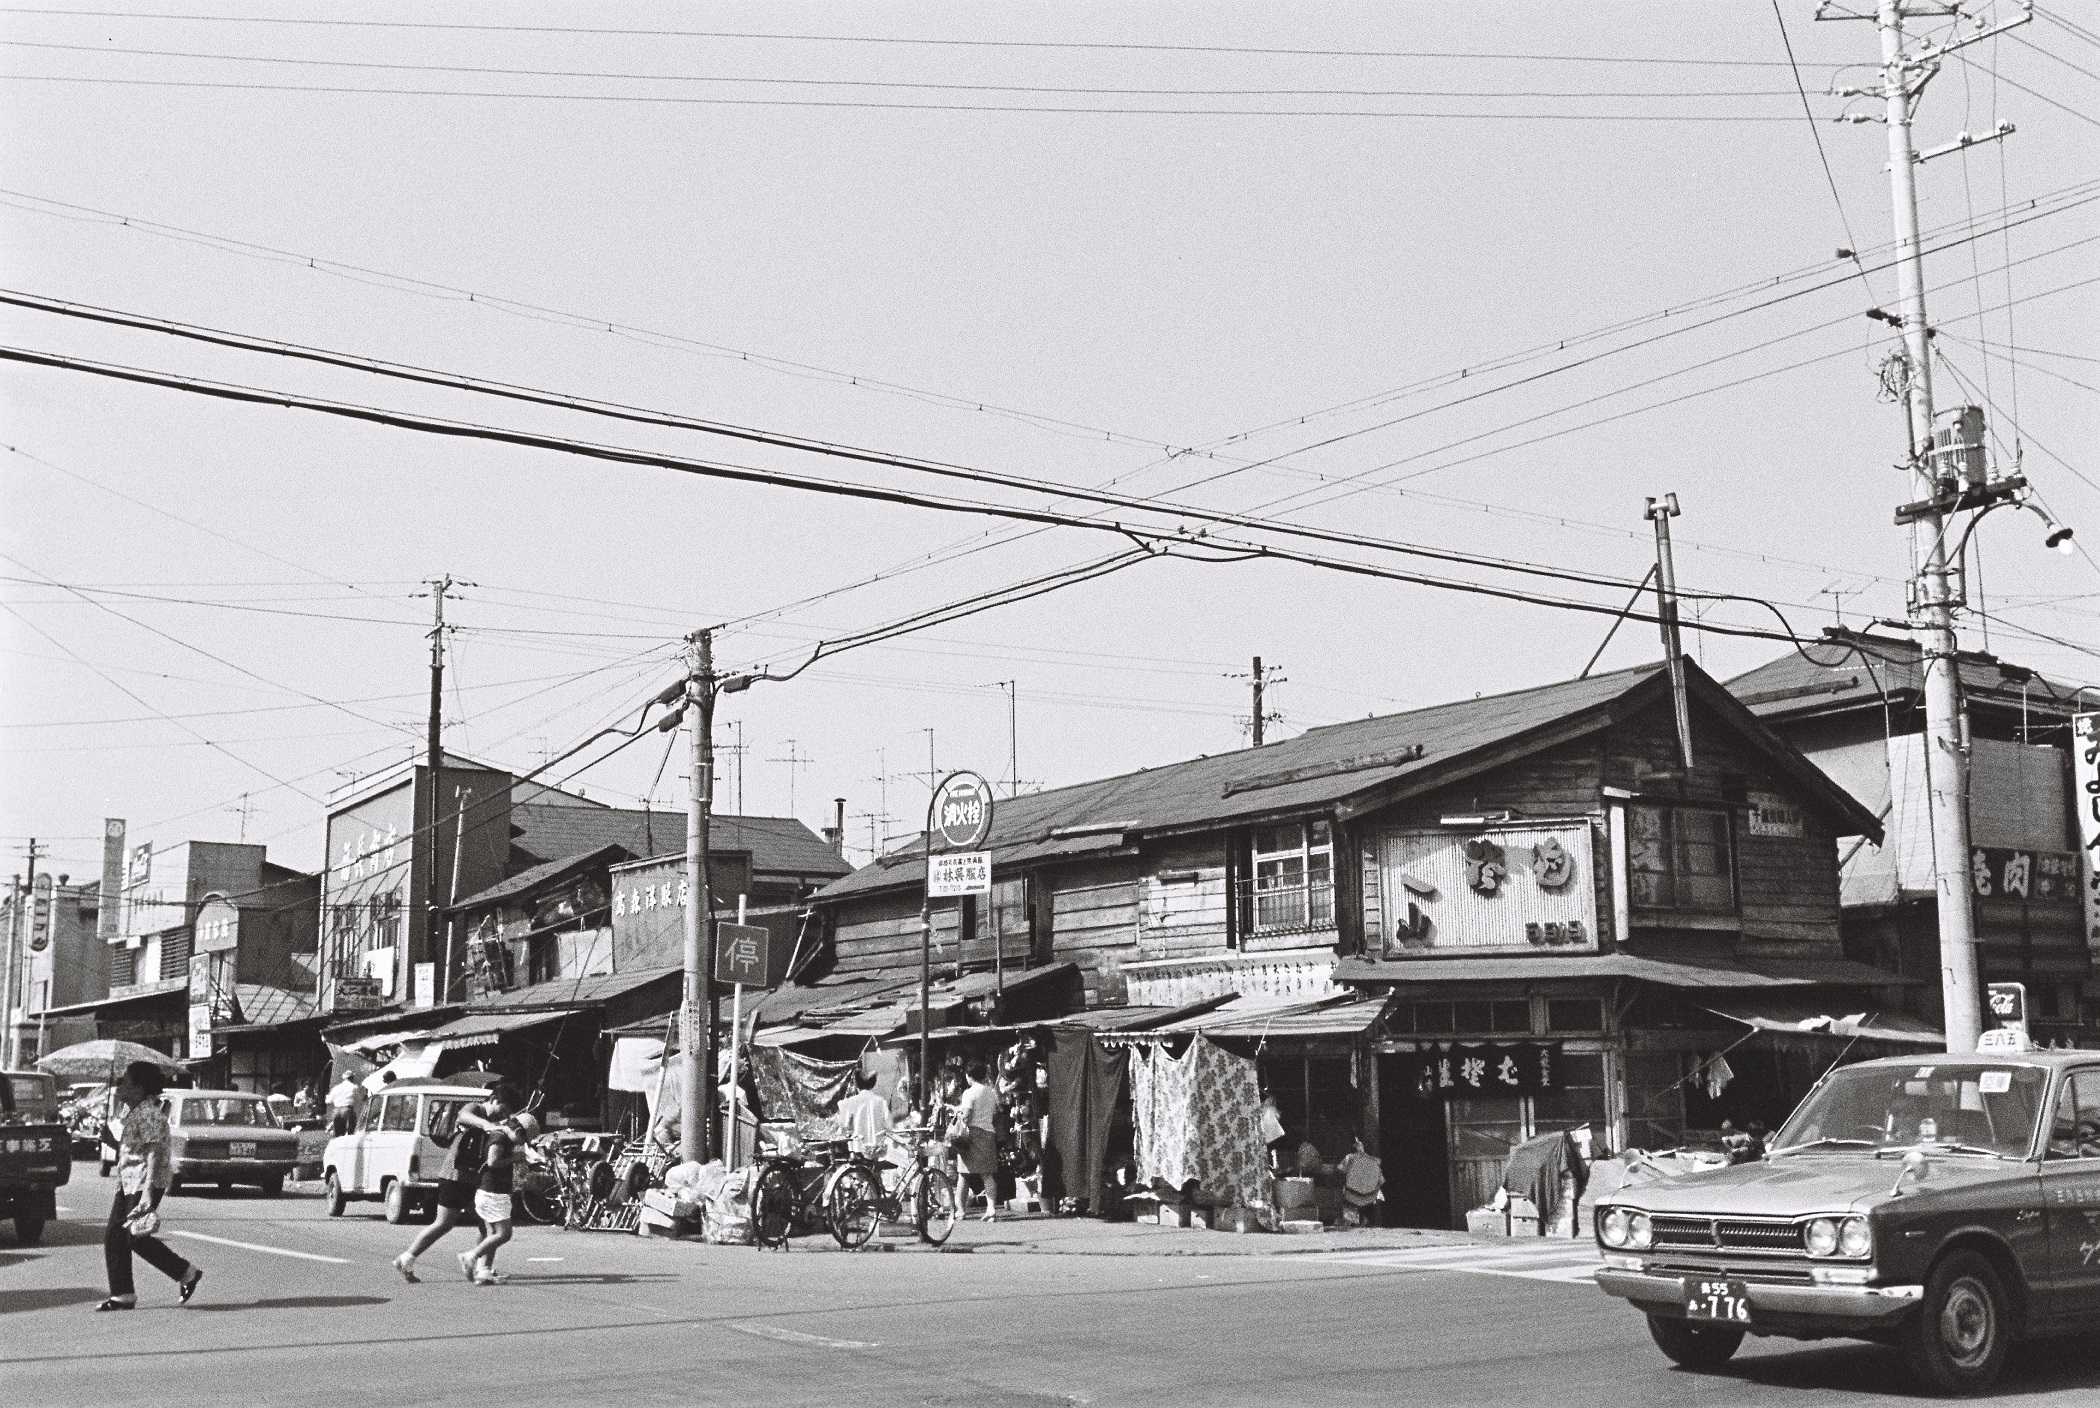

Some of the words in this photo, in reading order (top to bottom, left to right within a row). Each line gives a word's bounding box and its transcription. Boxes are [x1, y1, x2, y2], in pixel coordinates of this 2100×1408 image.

[943, 799, 981, 827] 消火栓
[724, 936, 760, 974] 停
[1989, 993, 2016, 1015] Cola
[1983, 1032, 2017, 1047] 三八五
